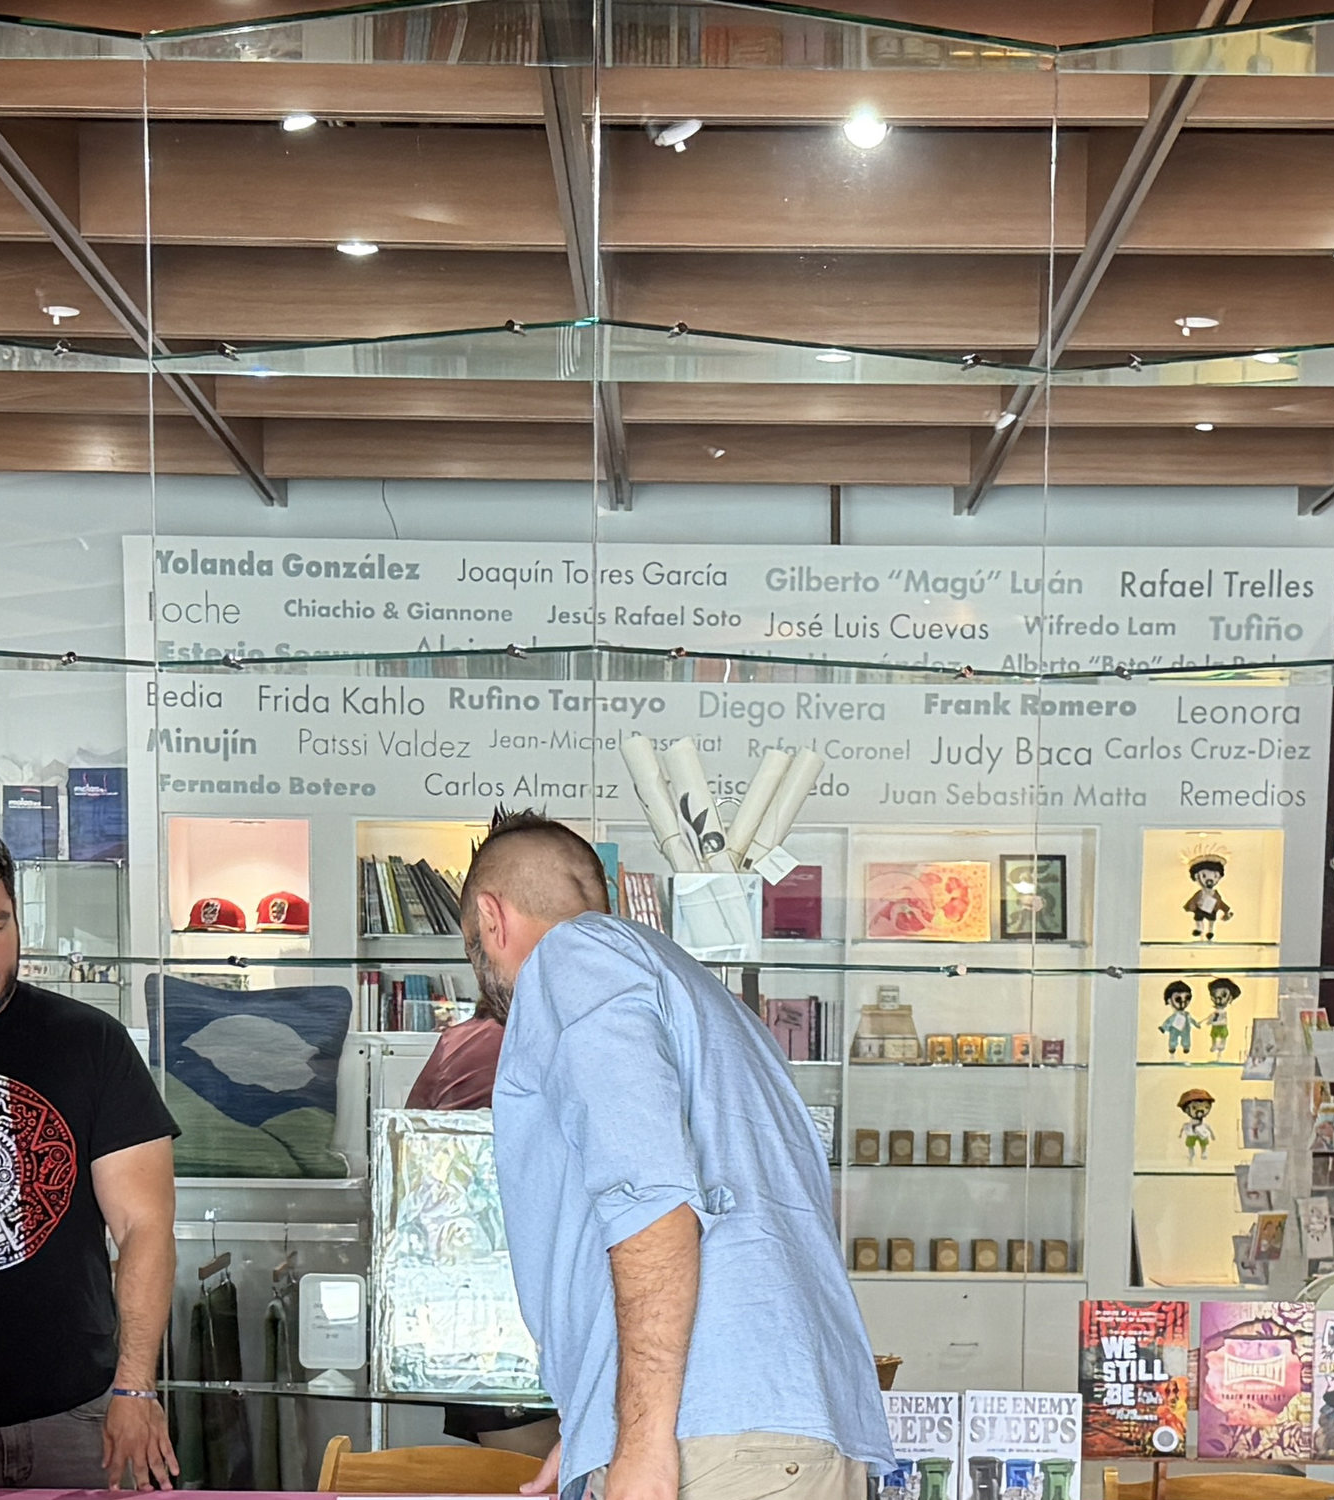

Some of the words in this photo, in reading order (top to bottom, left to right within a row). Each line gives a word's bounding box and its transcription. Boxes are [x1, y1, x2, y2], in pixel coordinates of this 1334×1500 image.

[155, 549, 273, 577] Yolanda
[282, 553, 420, 580] González
[457, 558, 554, 590] Joaquín
[562, 560, 634, 586] Tores
[643, 561, 727, 586] García
[765, 566, 881, 593] Gilberto
[1010, 570, 1083, 595] Luán
[1121, 568, 1213, 599] Rafael
[1224, 569, 1315, 599] Trelles
[283, 599, 375, 620] Chiachio
[383, 601, 399, 620] &
[407, 602, 513, 623] Giannone
[547, 605, 606, 626] Jesús
[614, 606, 685, 627] Rafael
[693, 607, 742, 628] Soto
[764, 612, 823, 640] José
[834, 613, 881, 640] Luis
[889, 613, 989, 641] Cuevas
[1023, 614, 1120, 636] Wifredo
[1128, 616, 1177, 636] Lam
[1209, 614, 1303, 641] Tufiño
[1001, 653, 1080, 674] Alberto
[147, 681, 223, 708] Bedia
[259, 684, 330, 714] Frida
[343, 685, 425, 716] Kahlo
[449, 686, 540, 711] Rufino
[548, 688, 666, 720] Tamayo
[923, 692, 1011, 717] Frank
[1020, 693, 1137, 717] Romero
[699, 690, 785, 728] Diego
[796, 692, 886, 721] Rivera
[1177, 695, 1301, 726] Leonora
[146, 727, 257, 762] Minujín
[299, 728, 368, 757] Patssi
[378, 729, 472, 759] Valdez
[488, 728, 623, 752] Jean-Michel
[824, 738, 911, 762] Coronel
[1105, 736, 1182, 762] Carlos
[1190, 738, 1312, 762] Cruz-Diez
[930, 733, 1003, 775] Judy
[1016, 736, 1092, 766] Baca
[159, 774, 280, 796] Fernando
[289, 776, 376, 797] Botero
[424, 772, 505, 798] Carlos
[879, 783, 937, 805] Juan
[946, 782, 1064, 807] Sebastián
[1073, 784, 1147, 807] Matta
[1180, 778, 1307, 807] Remedios
[1100, 1336, 1137, 1360] WE
[1103, 1359, 1169, 1383] STILL
[889, 1396, 954, 1415] ENEMY
[970, 1396, 1007, 1414] THE
[1012, 1396, 1077, 1416] ENEMY
[1103, 1383, 1135, 1406] BE
[891, 1416, 954, 1444] EEPS
[970, 1416, 1077, 1445] SLEEPS
